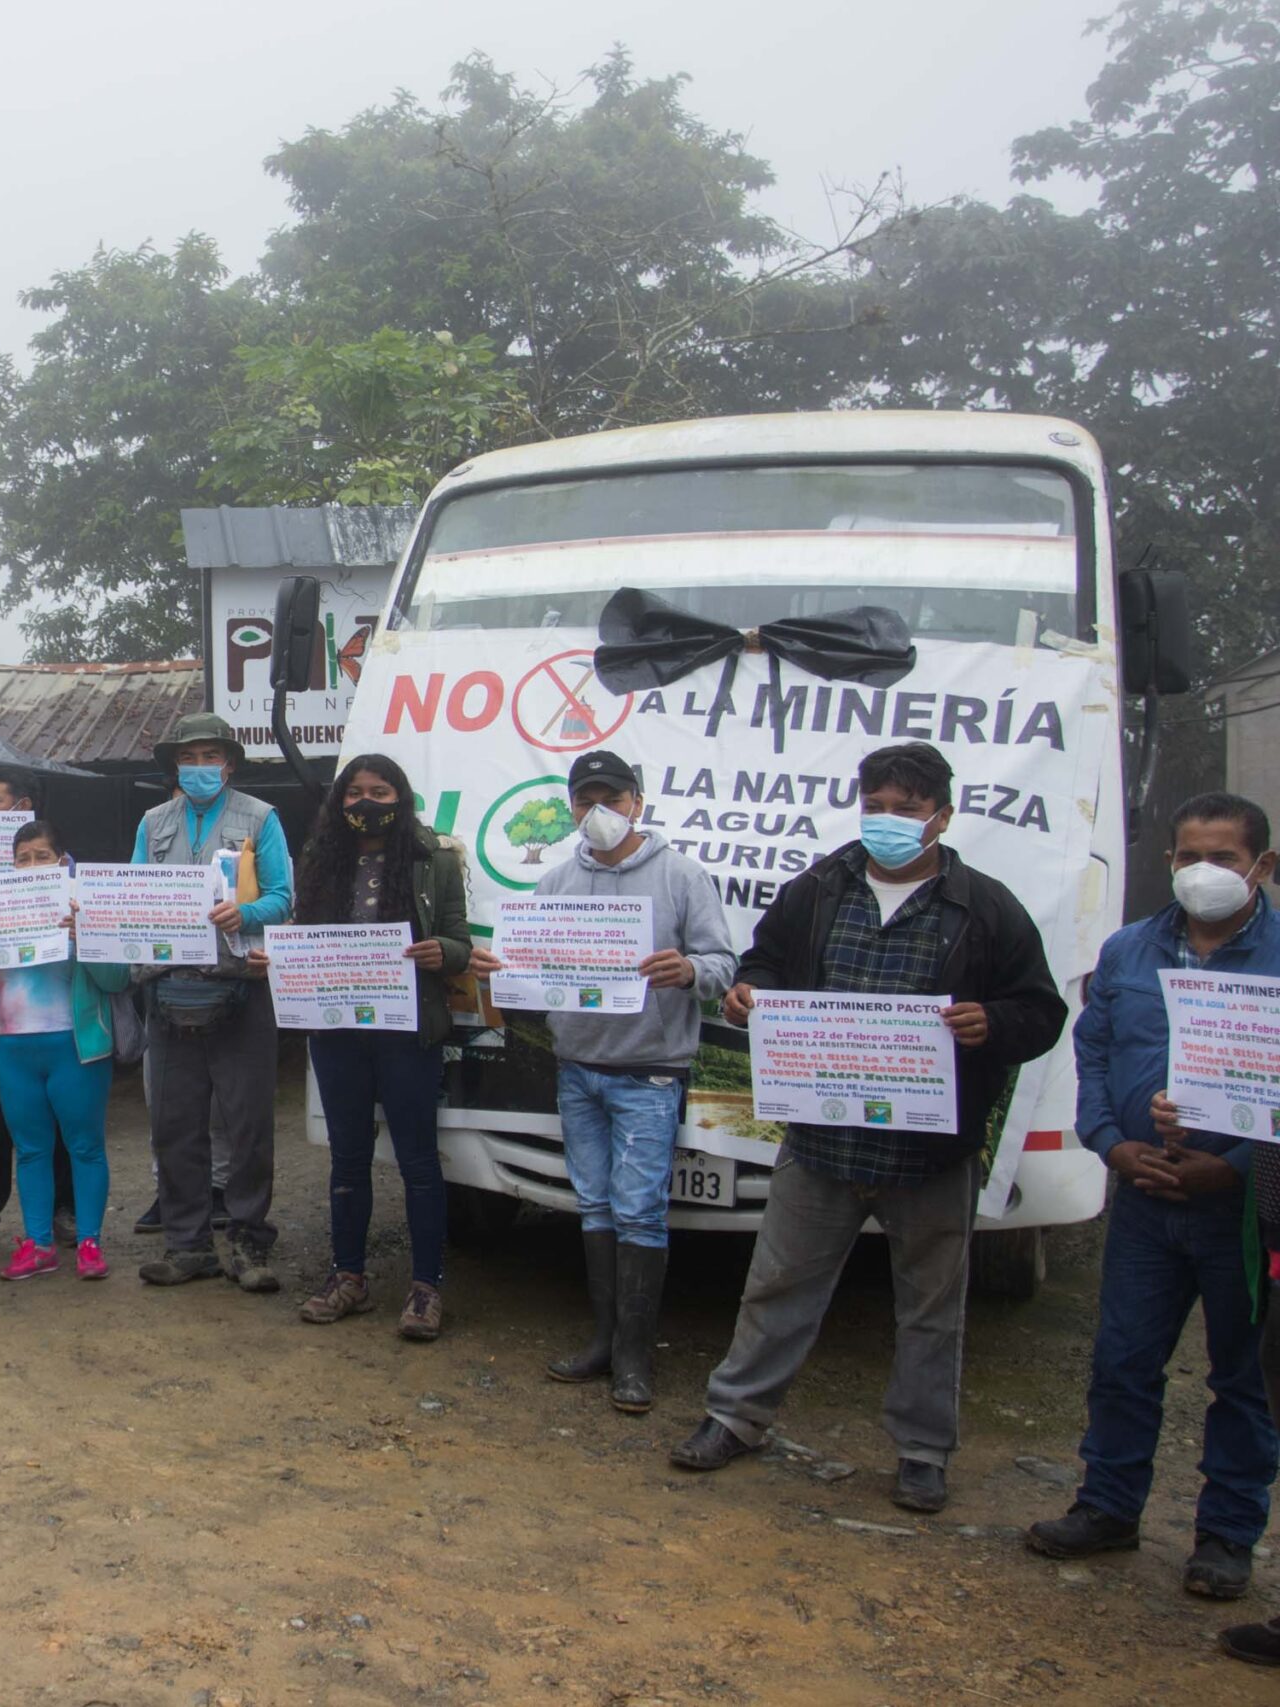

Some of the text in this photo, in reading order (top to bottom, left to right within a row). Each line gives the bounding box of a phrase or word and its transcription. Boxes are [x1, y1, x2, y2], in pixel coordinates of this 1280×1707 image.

[228, 698, 296, 712] VIDA
[383, 670, 1066, 752] NO A LA MINERÍA
[661, 766, 716, 799] LA
[732, 769, 1051, 833] NATUEZA
[681, 807, 820, 840] AGUA
[36, 872, 60, 881] PACTO
[540, 903, 604, 911] ANTIMINERO
[306, 930, 366, 938] ANTIMINERO
[1170, 979, 1215, 992] FRENTE
[756, 999, 940, 1013] FRENTE ANTIMINERO PACTO
[1206, 1000, 1225, 1009] AGUA
[1240, 1003, 1259, 1012] VIDA
[880, 1019, 939, 1027] NATURALEZA
[1191, 1016, 1218, 1028] Lunes
[1221, 1019, 1232, 1029] 22
[1235, 1021, 1247, 1031] de
[776, 1029, 920, 1043] Lunes 22 de Febrero 2021
[819, 1041, 876, 1049] RESISTENCIA
[880, 1044, 936, 1052] ANTIMINERA
[773, 1059, 826, 1069] Victoria
[831, 1062, 914, 1074] defendemos
[759, 1067, 944, 1085] nuestra Madre Naturaleza
[774, 1080, 812, 1088] Parroquia
[860, 1085, 901, 1093] Existimos
[852, 1092, 885, 1100] Siempre
